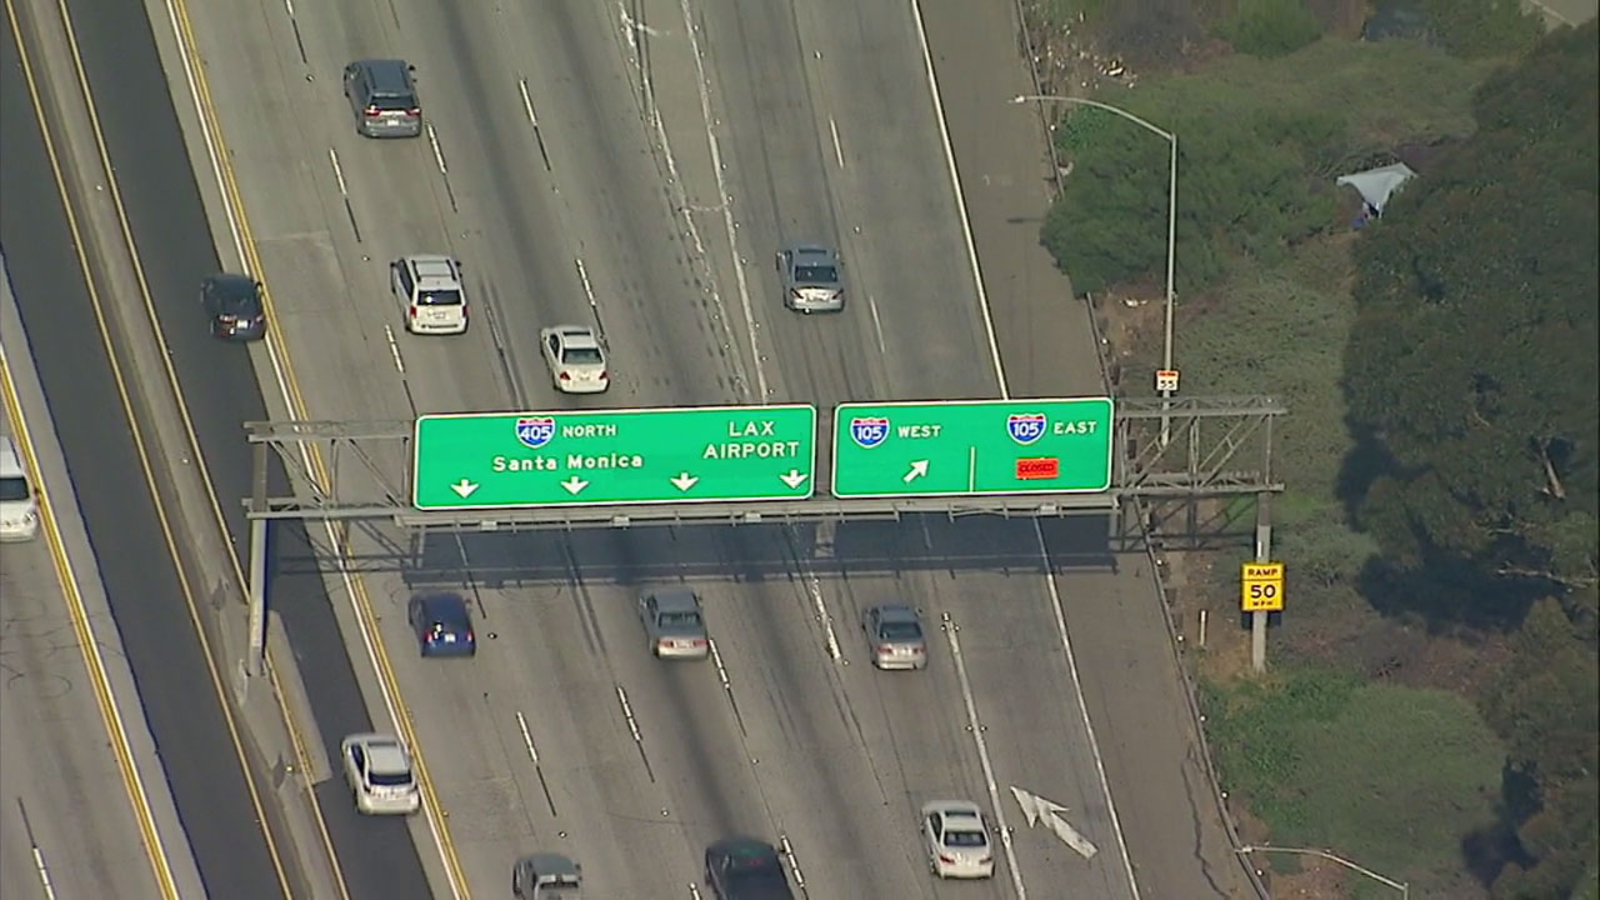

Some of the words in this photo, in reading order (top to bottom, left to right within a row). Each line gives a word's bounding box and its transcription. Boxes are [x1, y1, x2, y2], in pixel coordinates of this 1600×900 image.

[519, 425, 550, 441] 405
[562, 424, 618, 438] NORTH
[728, 420, 775, 437] LAX
[856, 426, 883, 441] 105
[897, 425, 942, 438] WEST
[1013, 422, 1039, 437] 105
[1053, 421, 1097, 435] EAST
[702, 441, 800, 460] AIRPORT
[492, 455, 557, 472] Santa
[567, 454, 643, 470] Monica
[1247, 568, 1278, 576] RAMP
[1250, 584, 1276, 599] 50
